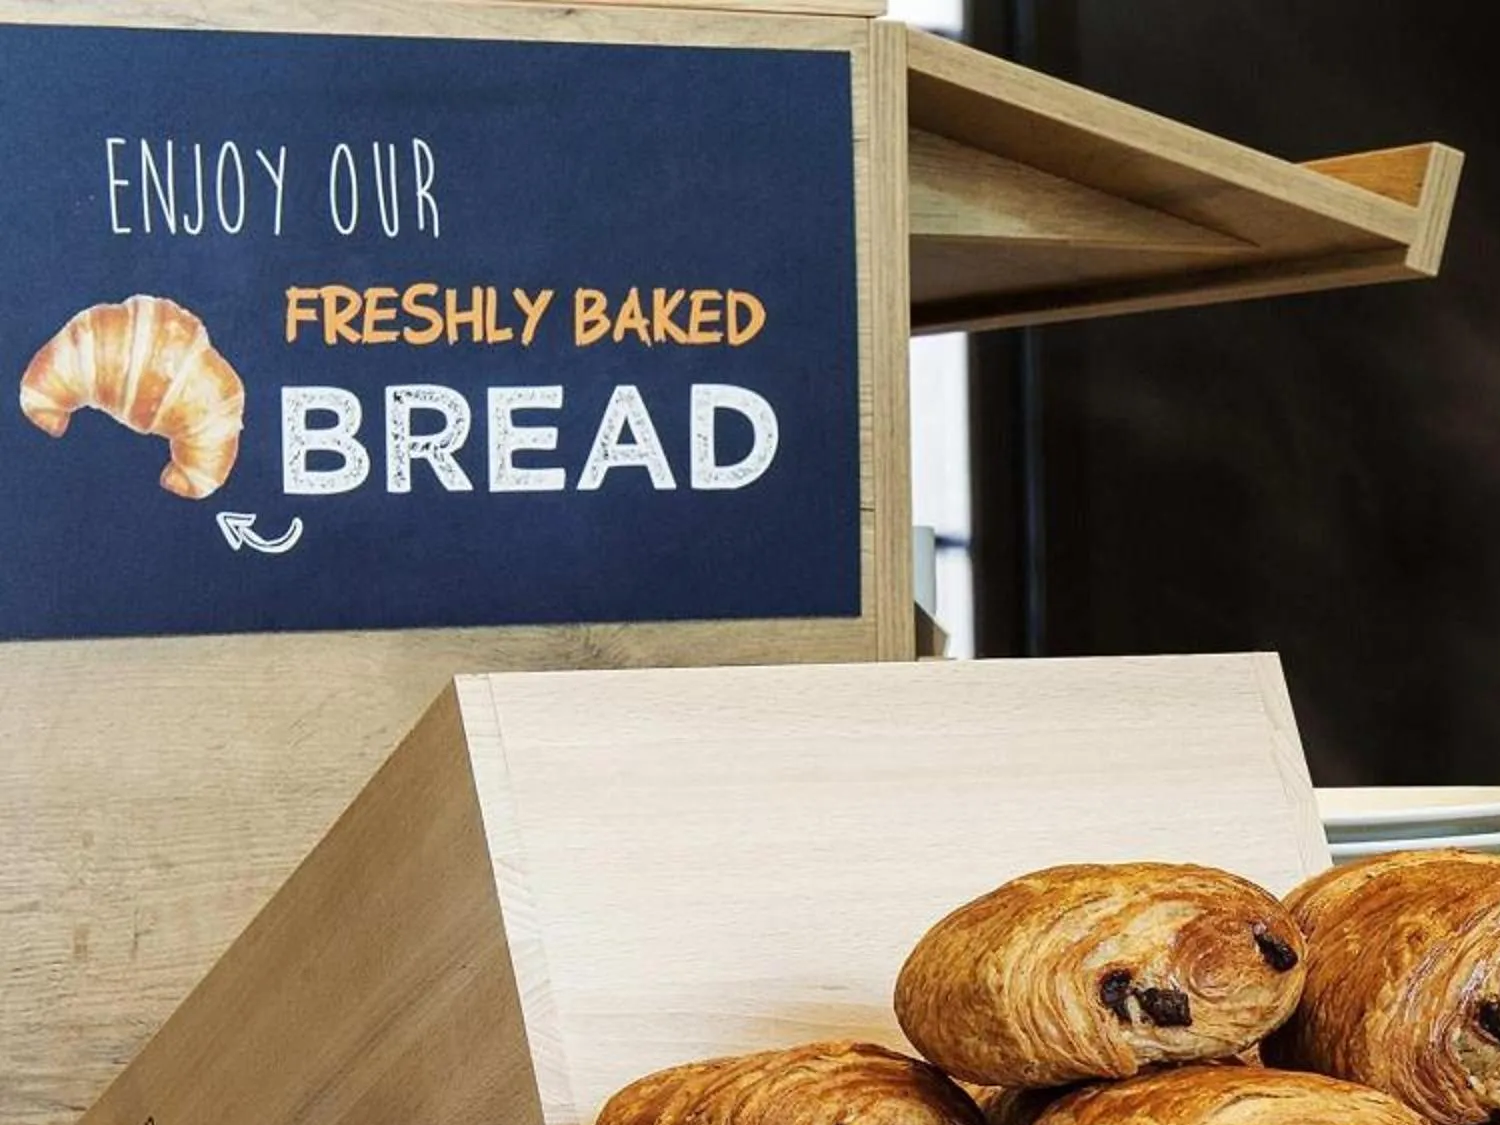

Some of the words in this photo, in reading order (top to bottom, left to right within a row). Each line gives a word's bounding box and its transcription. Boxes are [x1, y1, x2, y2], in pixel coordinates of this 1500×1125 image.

[105, 137, 287, 235] ENJOY
[329, 138, 440, 238] OUR
[284, 284, 553, 346] FRESHLY
[575, 288, 766, 346] BAKED
[280, 384, 780, 494] BREAD
